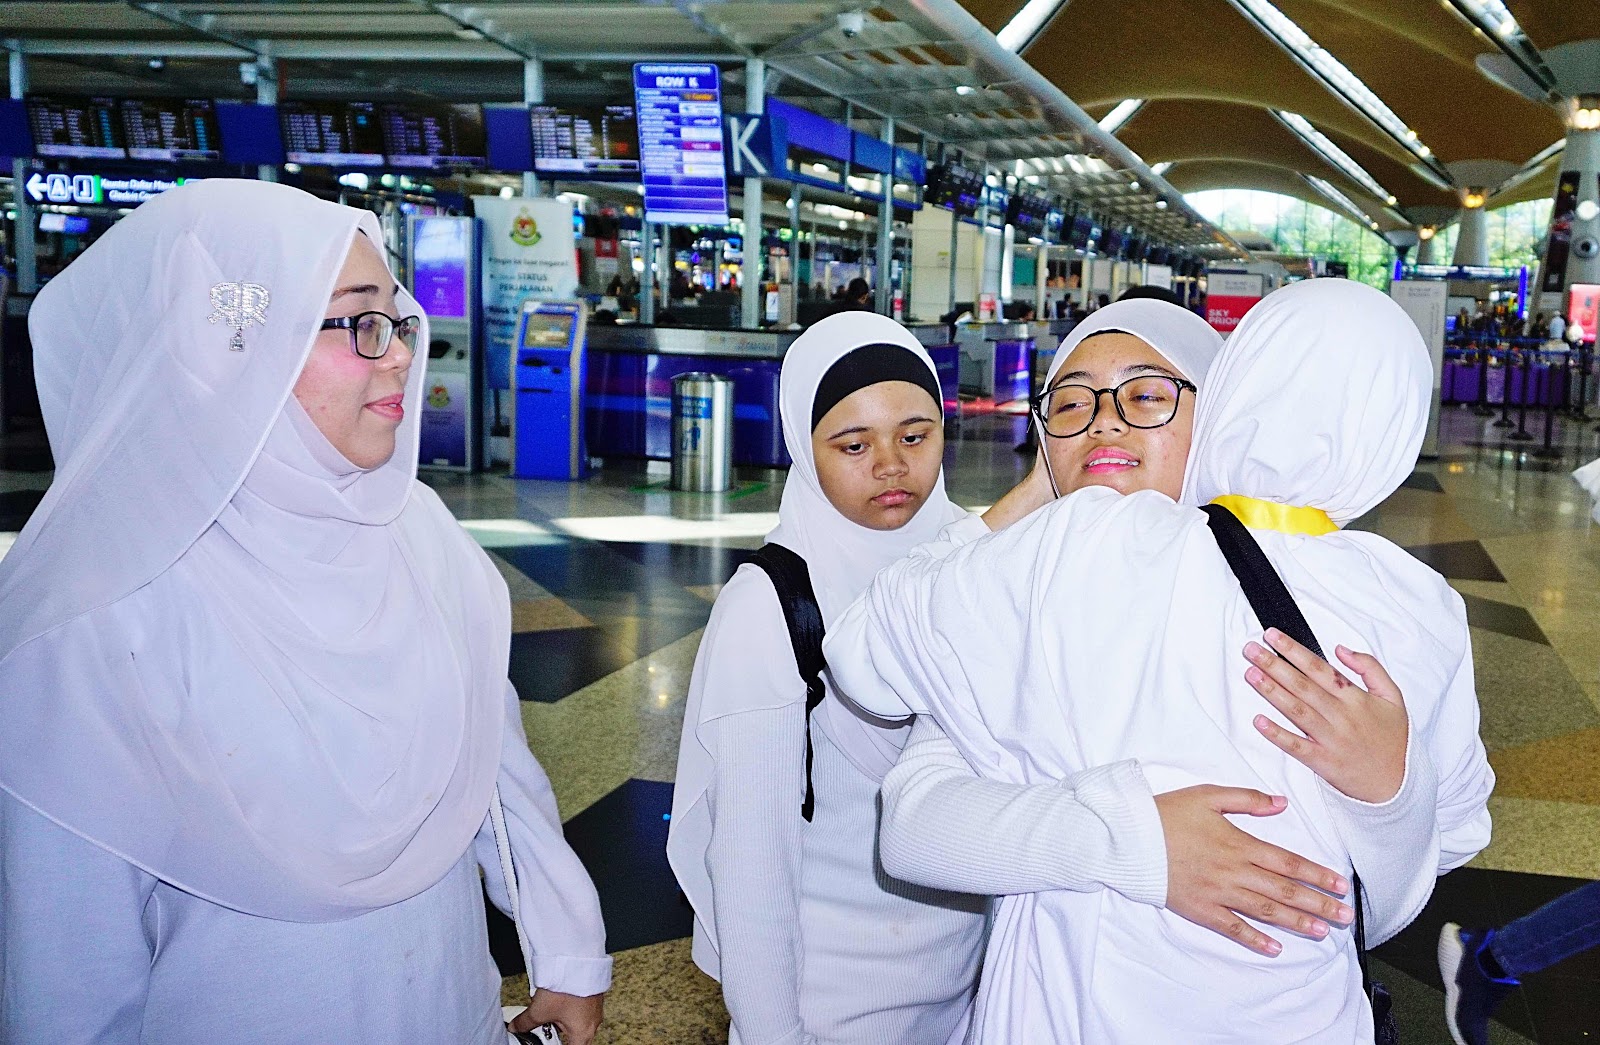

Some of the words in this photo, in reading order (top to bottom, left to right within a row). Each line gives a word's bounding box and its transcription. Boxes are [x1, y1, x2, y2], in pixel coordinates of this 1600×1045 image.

[656, 76, 686, 88] ROW
[688, 77, 699, 88] K
[730, 117, 767, 174] K
[51, 178, 66, 196] A
[80, 179, 91, 197] J
[1208, 308, 1229, 317] SKY
[1208, 316, 1240, 325] PRIOR
